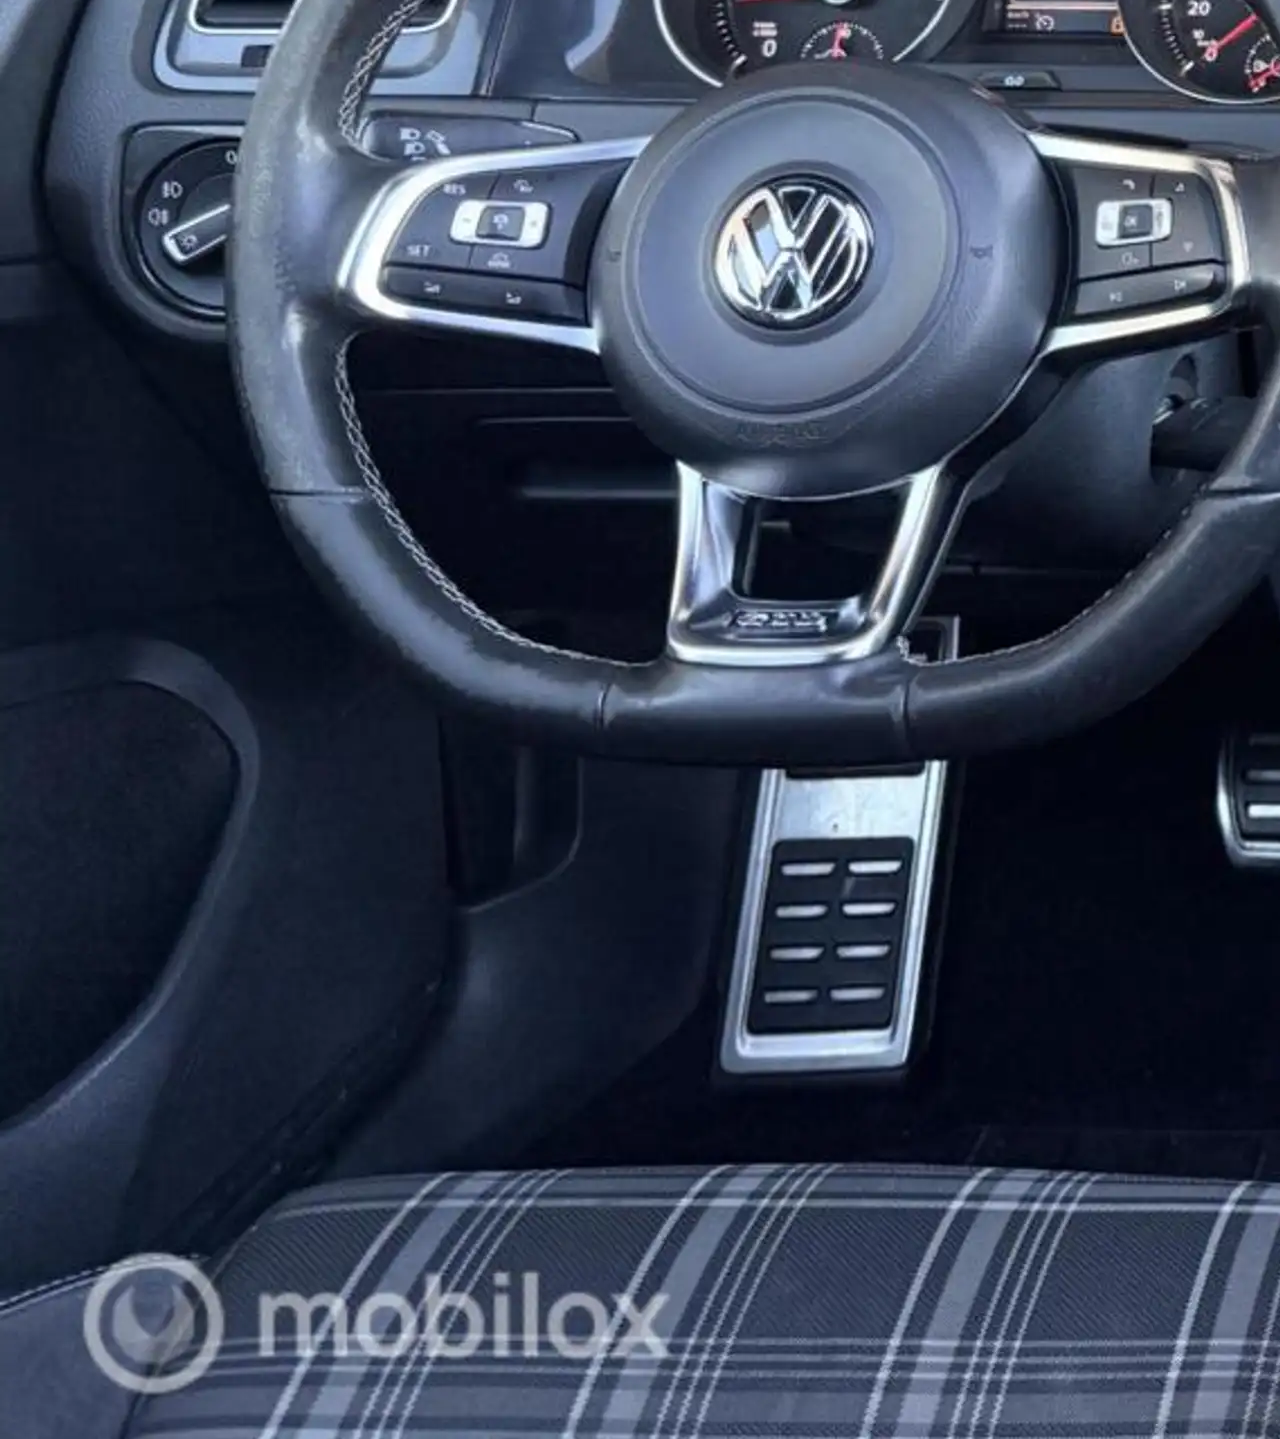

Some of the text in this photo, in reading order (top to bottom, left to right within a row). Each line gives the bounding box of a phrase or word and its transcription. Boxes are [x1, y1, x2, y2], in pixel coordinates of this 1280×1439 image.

[1187, 0, 1211, 16] 20
[762, 38, 777, 58] 0
[443, 182, 466, 196] RES
[406, 244, 431, 258] SET
